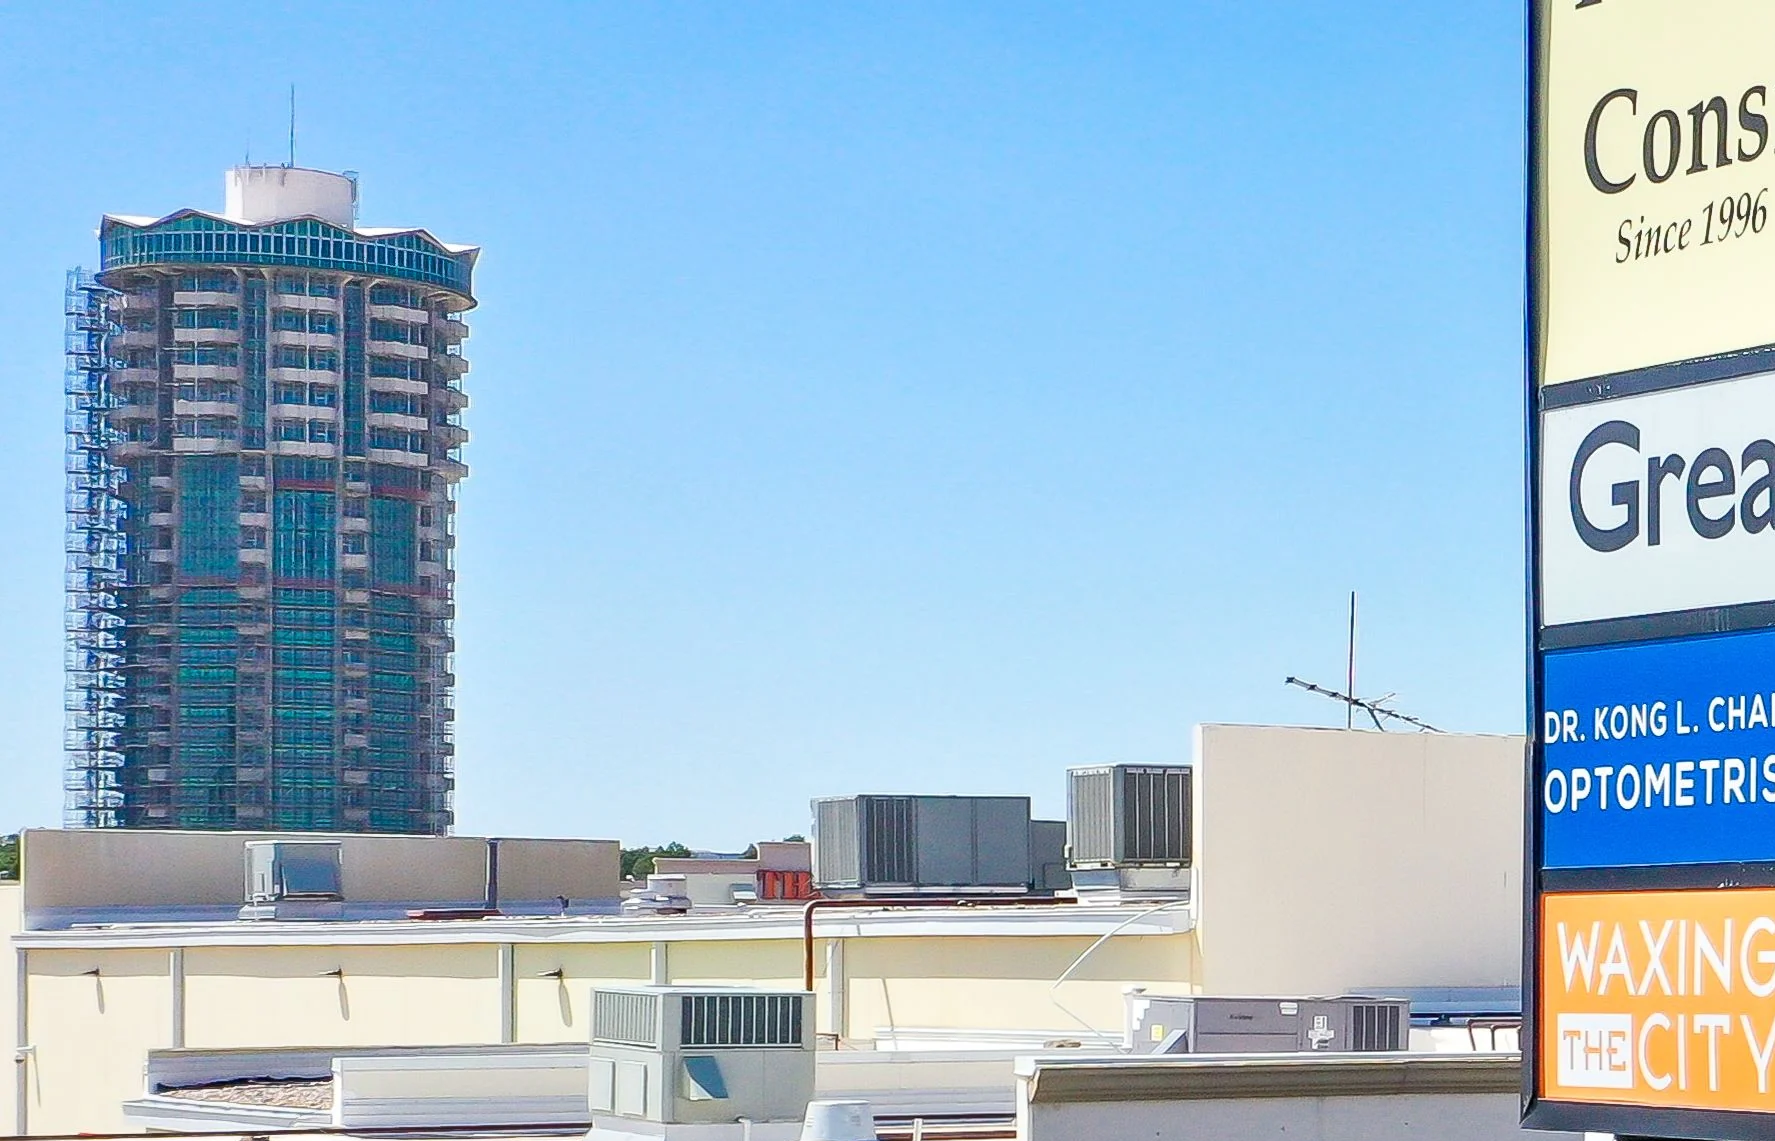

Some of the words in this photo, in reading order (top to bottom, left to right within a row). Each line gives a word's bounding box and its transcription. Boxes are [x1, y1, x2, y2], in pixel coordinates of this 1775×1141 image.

[1615, 219, 1691, 264] Since
[1699, 188, 1768, 246] 1996
[1544, 709, 1586, 744] DR.
[1594, 702, 1667, 740] KONG
[1676, 700, 1699, 734] L.
[1562, 1030, 1628, 1073] THE
